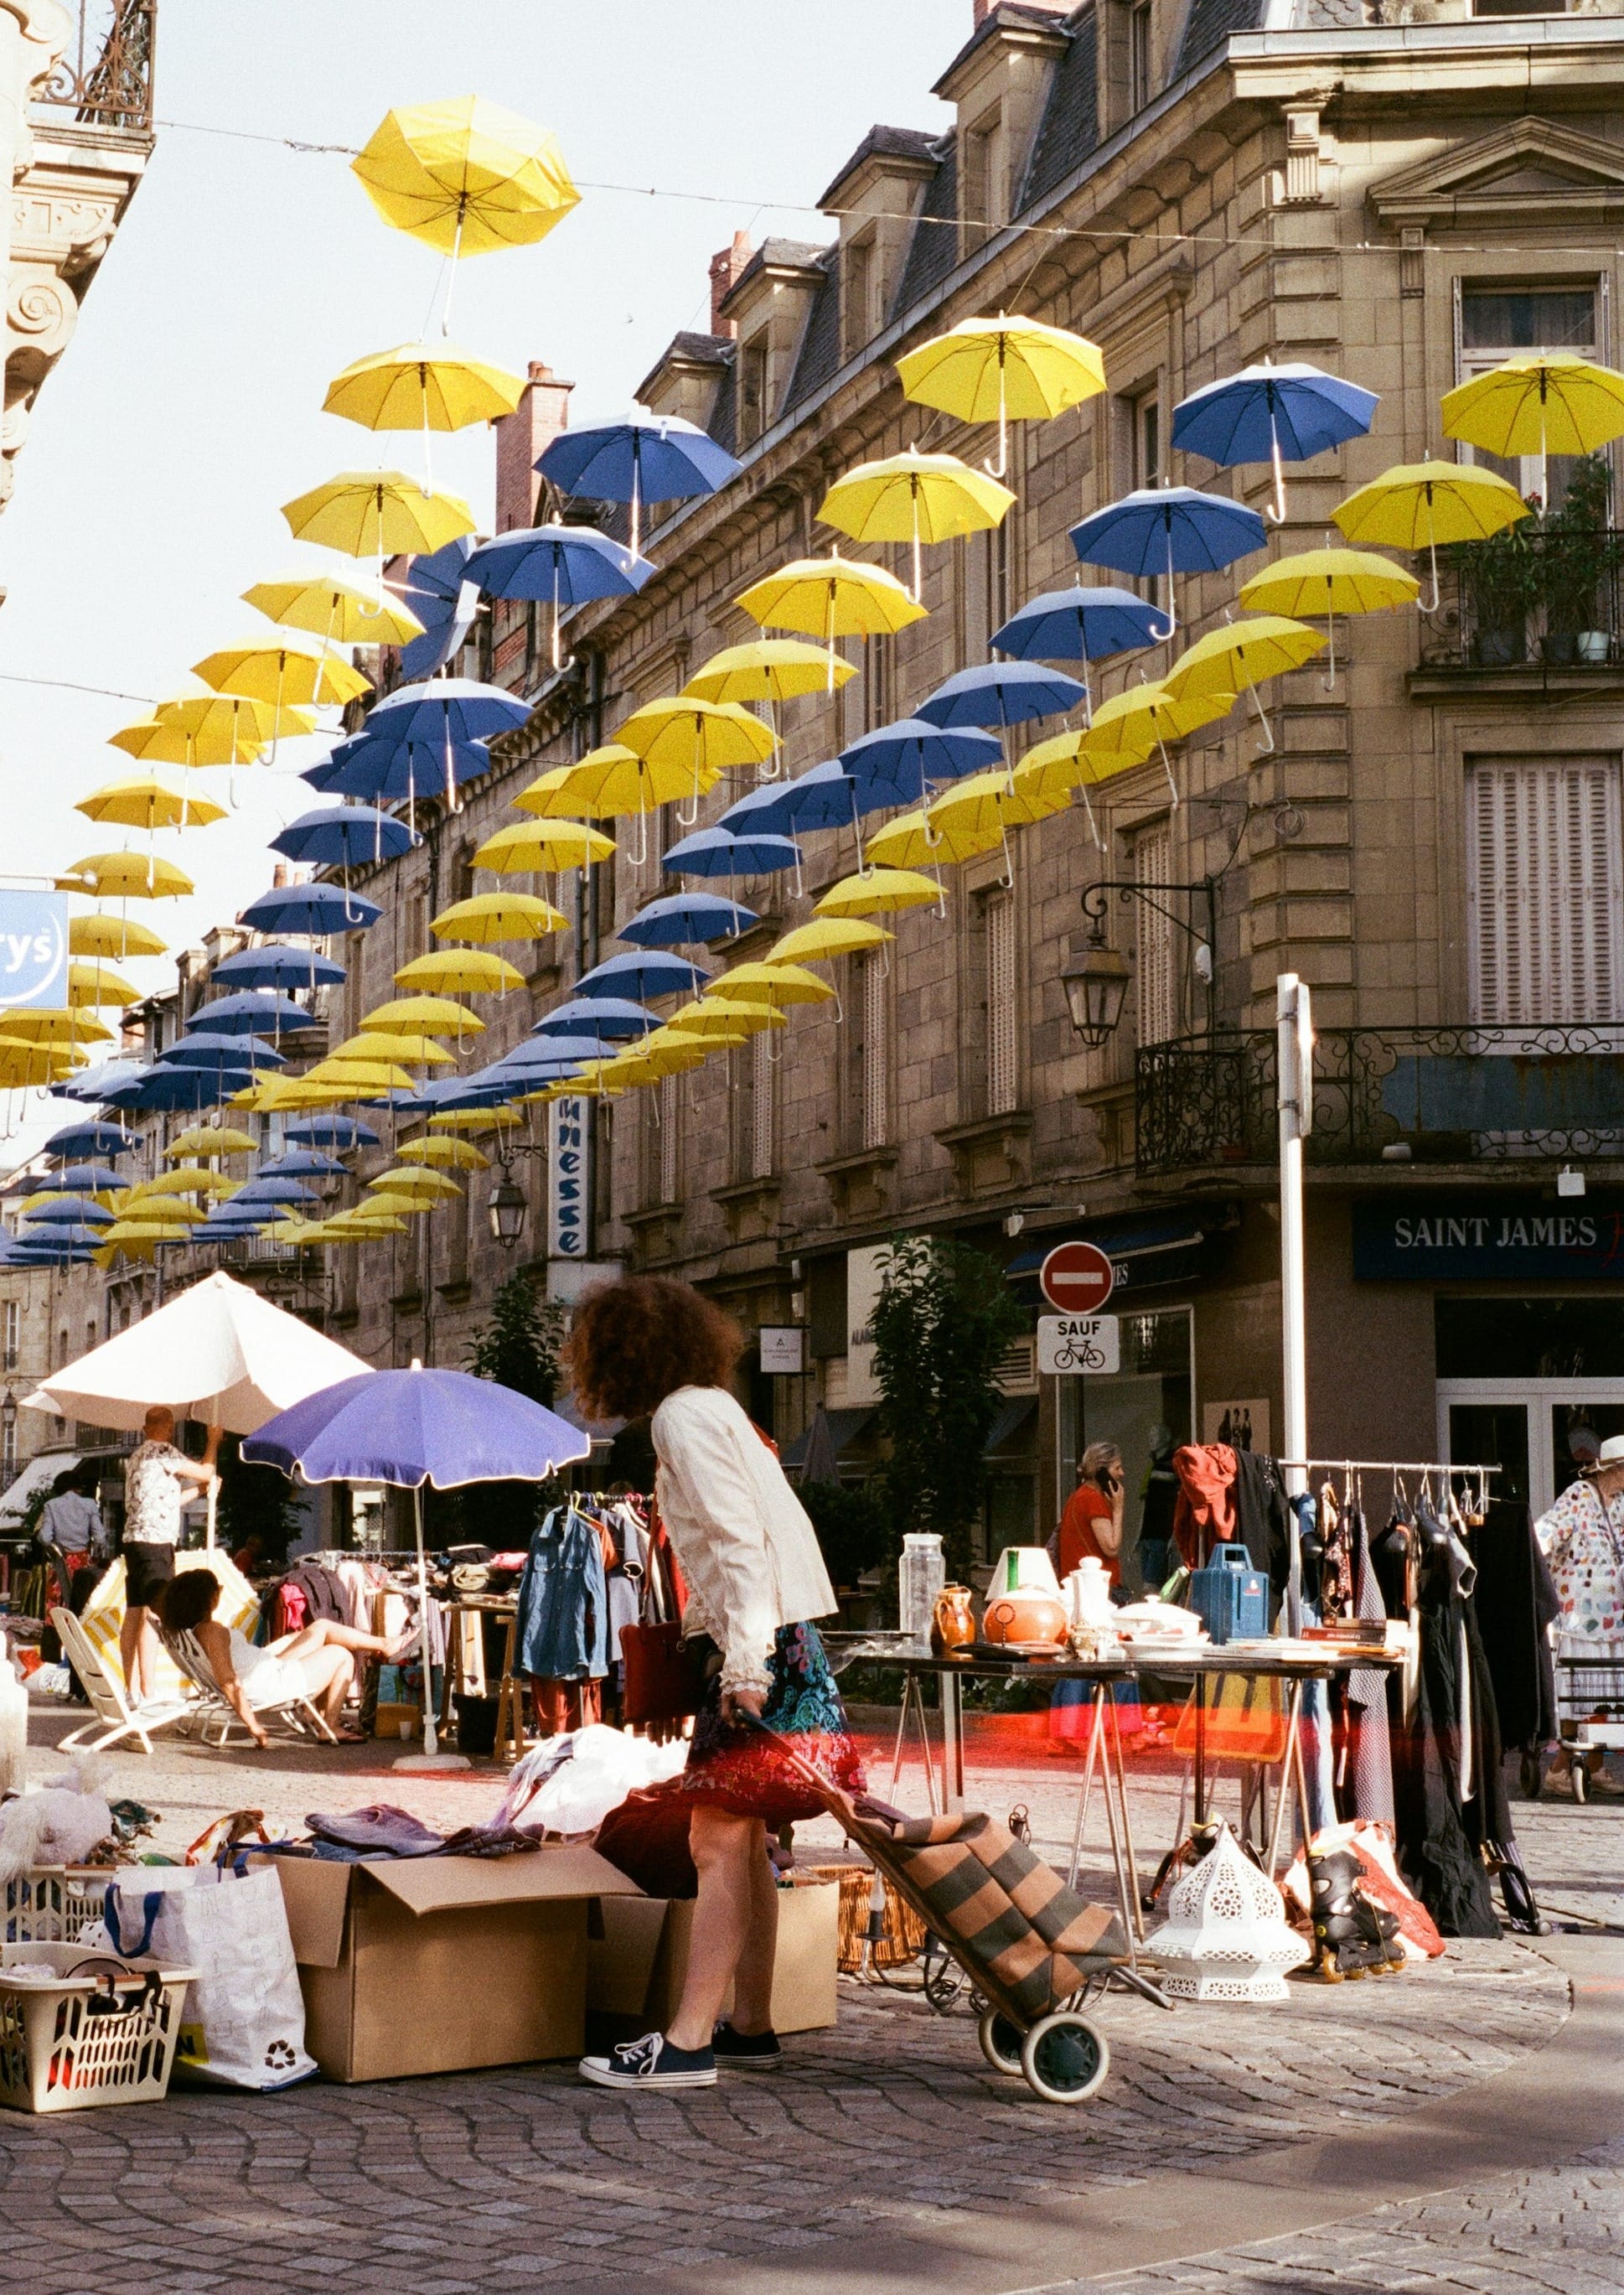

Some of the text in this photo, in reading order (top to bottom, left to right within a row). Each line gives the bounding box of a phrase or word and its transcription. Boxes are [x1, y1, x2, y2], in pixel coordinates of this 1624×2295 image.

[1394, 1218, 1489, 1247] SAINT
[1497, 1217, 1597, 1247] JAMES
[1058, 1321, 1100, 1335] SAUF
